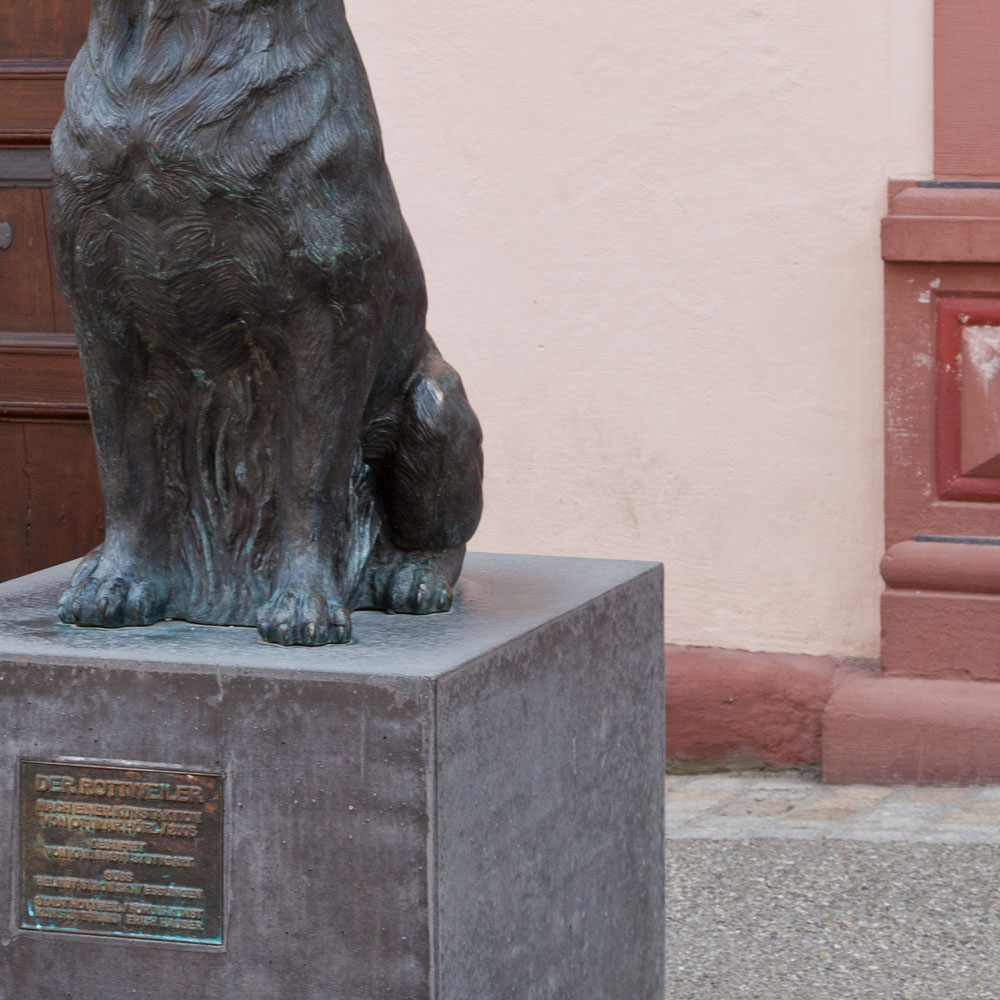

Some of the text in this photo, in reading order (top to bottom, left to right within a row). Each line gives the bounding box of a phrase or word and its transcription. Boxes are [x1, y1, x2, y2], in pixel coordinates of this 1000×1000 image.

[35, 774, 203, 804] DER ROTTWEILER
[36, 798, 71, 814] NACH
